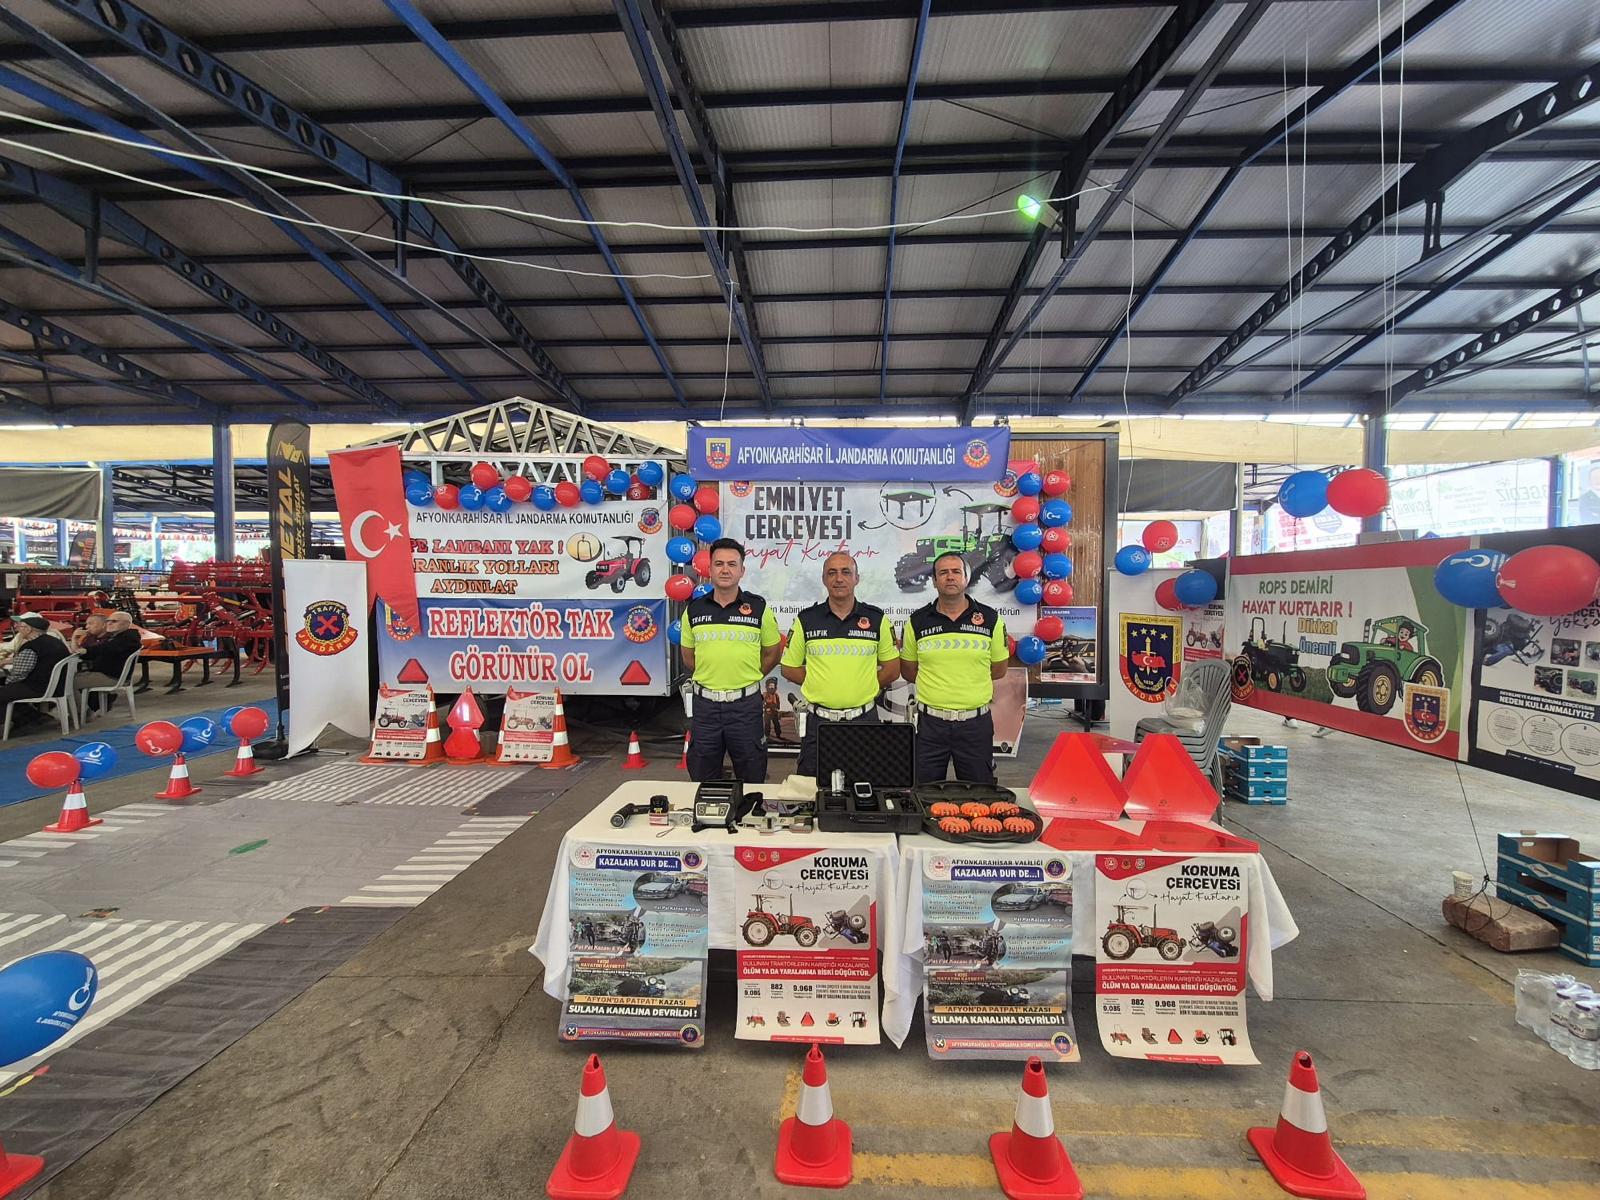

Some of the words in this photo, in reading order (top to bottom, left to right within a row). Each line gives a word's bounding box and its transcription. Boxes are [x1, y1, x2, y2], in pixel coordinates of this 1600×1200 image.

[737, 444, 824, 465] AFYONKARAHİSAR
[825, 444, 835, 465] İL
[835, 447, 889, 465] JANDARMA
[890, 444, 956, 465] KOMUTANLIĞI
[754, 481, 846, 512] EMNİYET
[416, 510, 503, 524] AFYONKARAHİSAR
[515, 512, 568, 524] JANDARMA
[569, 510, 634, 524] KOMUTANLIĞI
[744, 510, 852, 543] ÇERÇEVESİ
[410, 538, 428, 553] PE
[432, 539, 512, 554] LAMBANI
[515, 540, 550, 554] YAK
[557, 540, 564, 554] !
[744, 538, 802, 569] ayat
[413, 558, 480, 574] RANLIK
[483, 559, 559, 575] YOLLARI
[430, 579, 518, 594] AYDINLAT
[1259, 579, 1288, 595] ROPS
[1290, 575, 1334, 594] DEMİRİ
[1242, 600, 1277, 615] HAYAT
[1279, 600, 1345, 618] KURTARIR
[1348, 600, 1353, 617] !
[428, 603, 563, 639] REFLEKTÖR
[567, 609, 614, 639] TAK
[692, 615, 713, 625] TRAFİK
[1297, 617, 1338, 635] Dikkat
[806, 630, 828, 639] TRAFİK
[920, 625, 943, 637] TRAFİK
[296, 629, 358, 653] JANDARMA
[1299, 634, 1337, 656] Önemli
[450, 646, 556, 682] GÖRÜNÜR
[562, 654, 593, 682] OL
[1123, 674, 1177, 701] JANDARA
[1500, 696, 1524, 707] NEDEN
[1525, 699, 1595, 719] KULLANMALIYIZ?
[599, 857, 639, 867] KAZALARA
[640, 859, 656, 867] DUR
[814, 857, 868, 868] KORUMA
[800, 868, 869, 882] ÇERÇEVESİ
[954, 869, 997, 878] KAZALARA
[1000, 869, 1016, 878] DUR
[1181, 865, 1240, 877] KORUMA
[1166, 877, 1241, 890] ÇERÇEVESİ
[743, 967, 761, 975] ÖLÜM
[1141, 983, 1180, 991] YARALANMA
[659, 998, 687, 1006] KAZASI
[568, 1004, 604, 1013] SULAMA
[606, 1006, 651, 1016] KANALINA
[652, 1008, 693, 1017] DEVRİLDİ
[931, 1016, 968, 1024] SULAMA
[970, 1016, 1017, 1025] KANALINA
[1018, 1015, 1060, 1025] DEVRİLDİ
